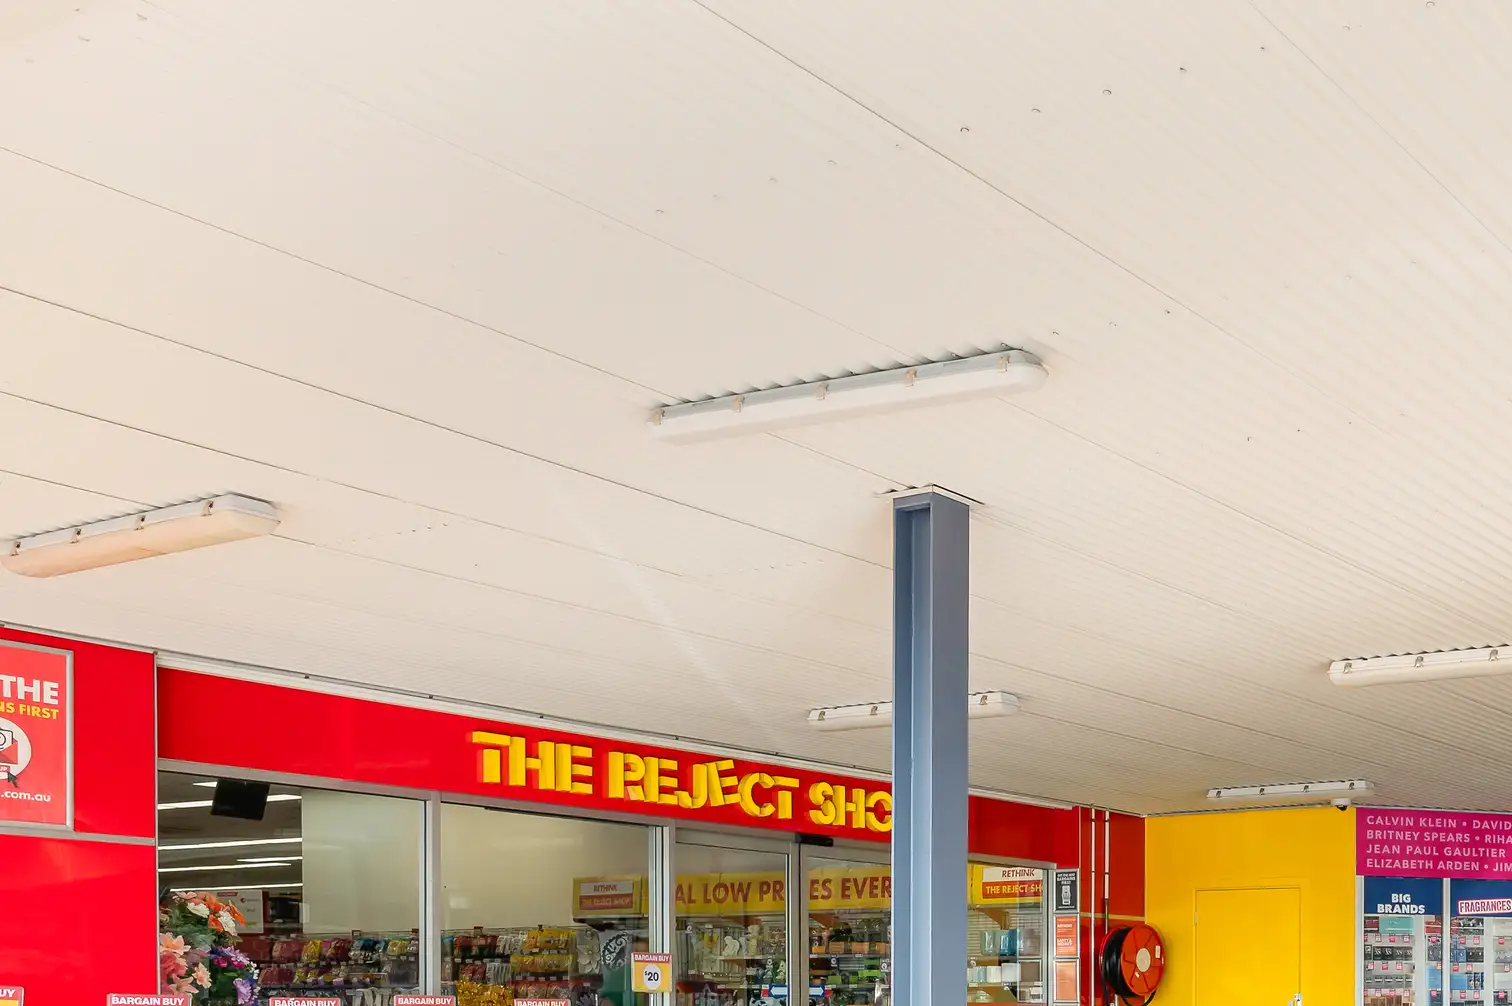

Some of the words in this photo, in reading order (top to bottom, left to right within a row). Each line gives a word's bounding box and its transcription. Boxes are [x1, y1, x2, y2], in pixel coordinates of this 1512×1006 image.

[0, 673, 59, 705] THE
[19, 704, 59, 720] FIRST
[472, 731, 594, 795] THE
[607, 751, 799, 819] REJECT
[1366, 815, 1414, 826] CALVIN
[1419, 817, 1457, 828] KLEIN
[1472, 819, 1512, 831] DAVID
[1366, 830, 1420, 841] BRITNEY
[1424, 832, 1470, 843] SPEARS
[1366, 844, 1401, 855] JEAN
[1406, 846, 1439, 856] PAUL
[1444, 847, 1506, 858] GAULTIER
[1366, 858, 1434, 870] ELIZABETH
[1437, 860, 1480, 872] ARDEN
[1001, 868, 1035, 879] RETHINK
[702, 882, 752, 905] LOW
[985, 885, 1000, 895] THE
[1002, 883, 1028, 894] REJECT
[1030, 883, 1042, 894] SH
[1391, 893, 1412, 903] BIG
[1377, 904, 1426, 914] BRANDS
[1459, 900, 1512, 913] FRAGRANCES
[634, 954, 657, 962] BARGAIN
[657, 954, 670, 962] BUY
[645, 971, 659, 982] $20
[111, 996, 161, 1006] BARGAIN
[163, 997, 185, 1006] BUY
[397, 997, 435, 1006] BARGAIN
[436, 998, 452, 1006] BUY
